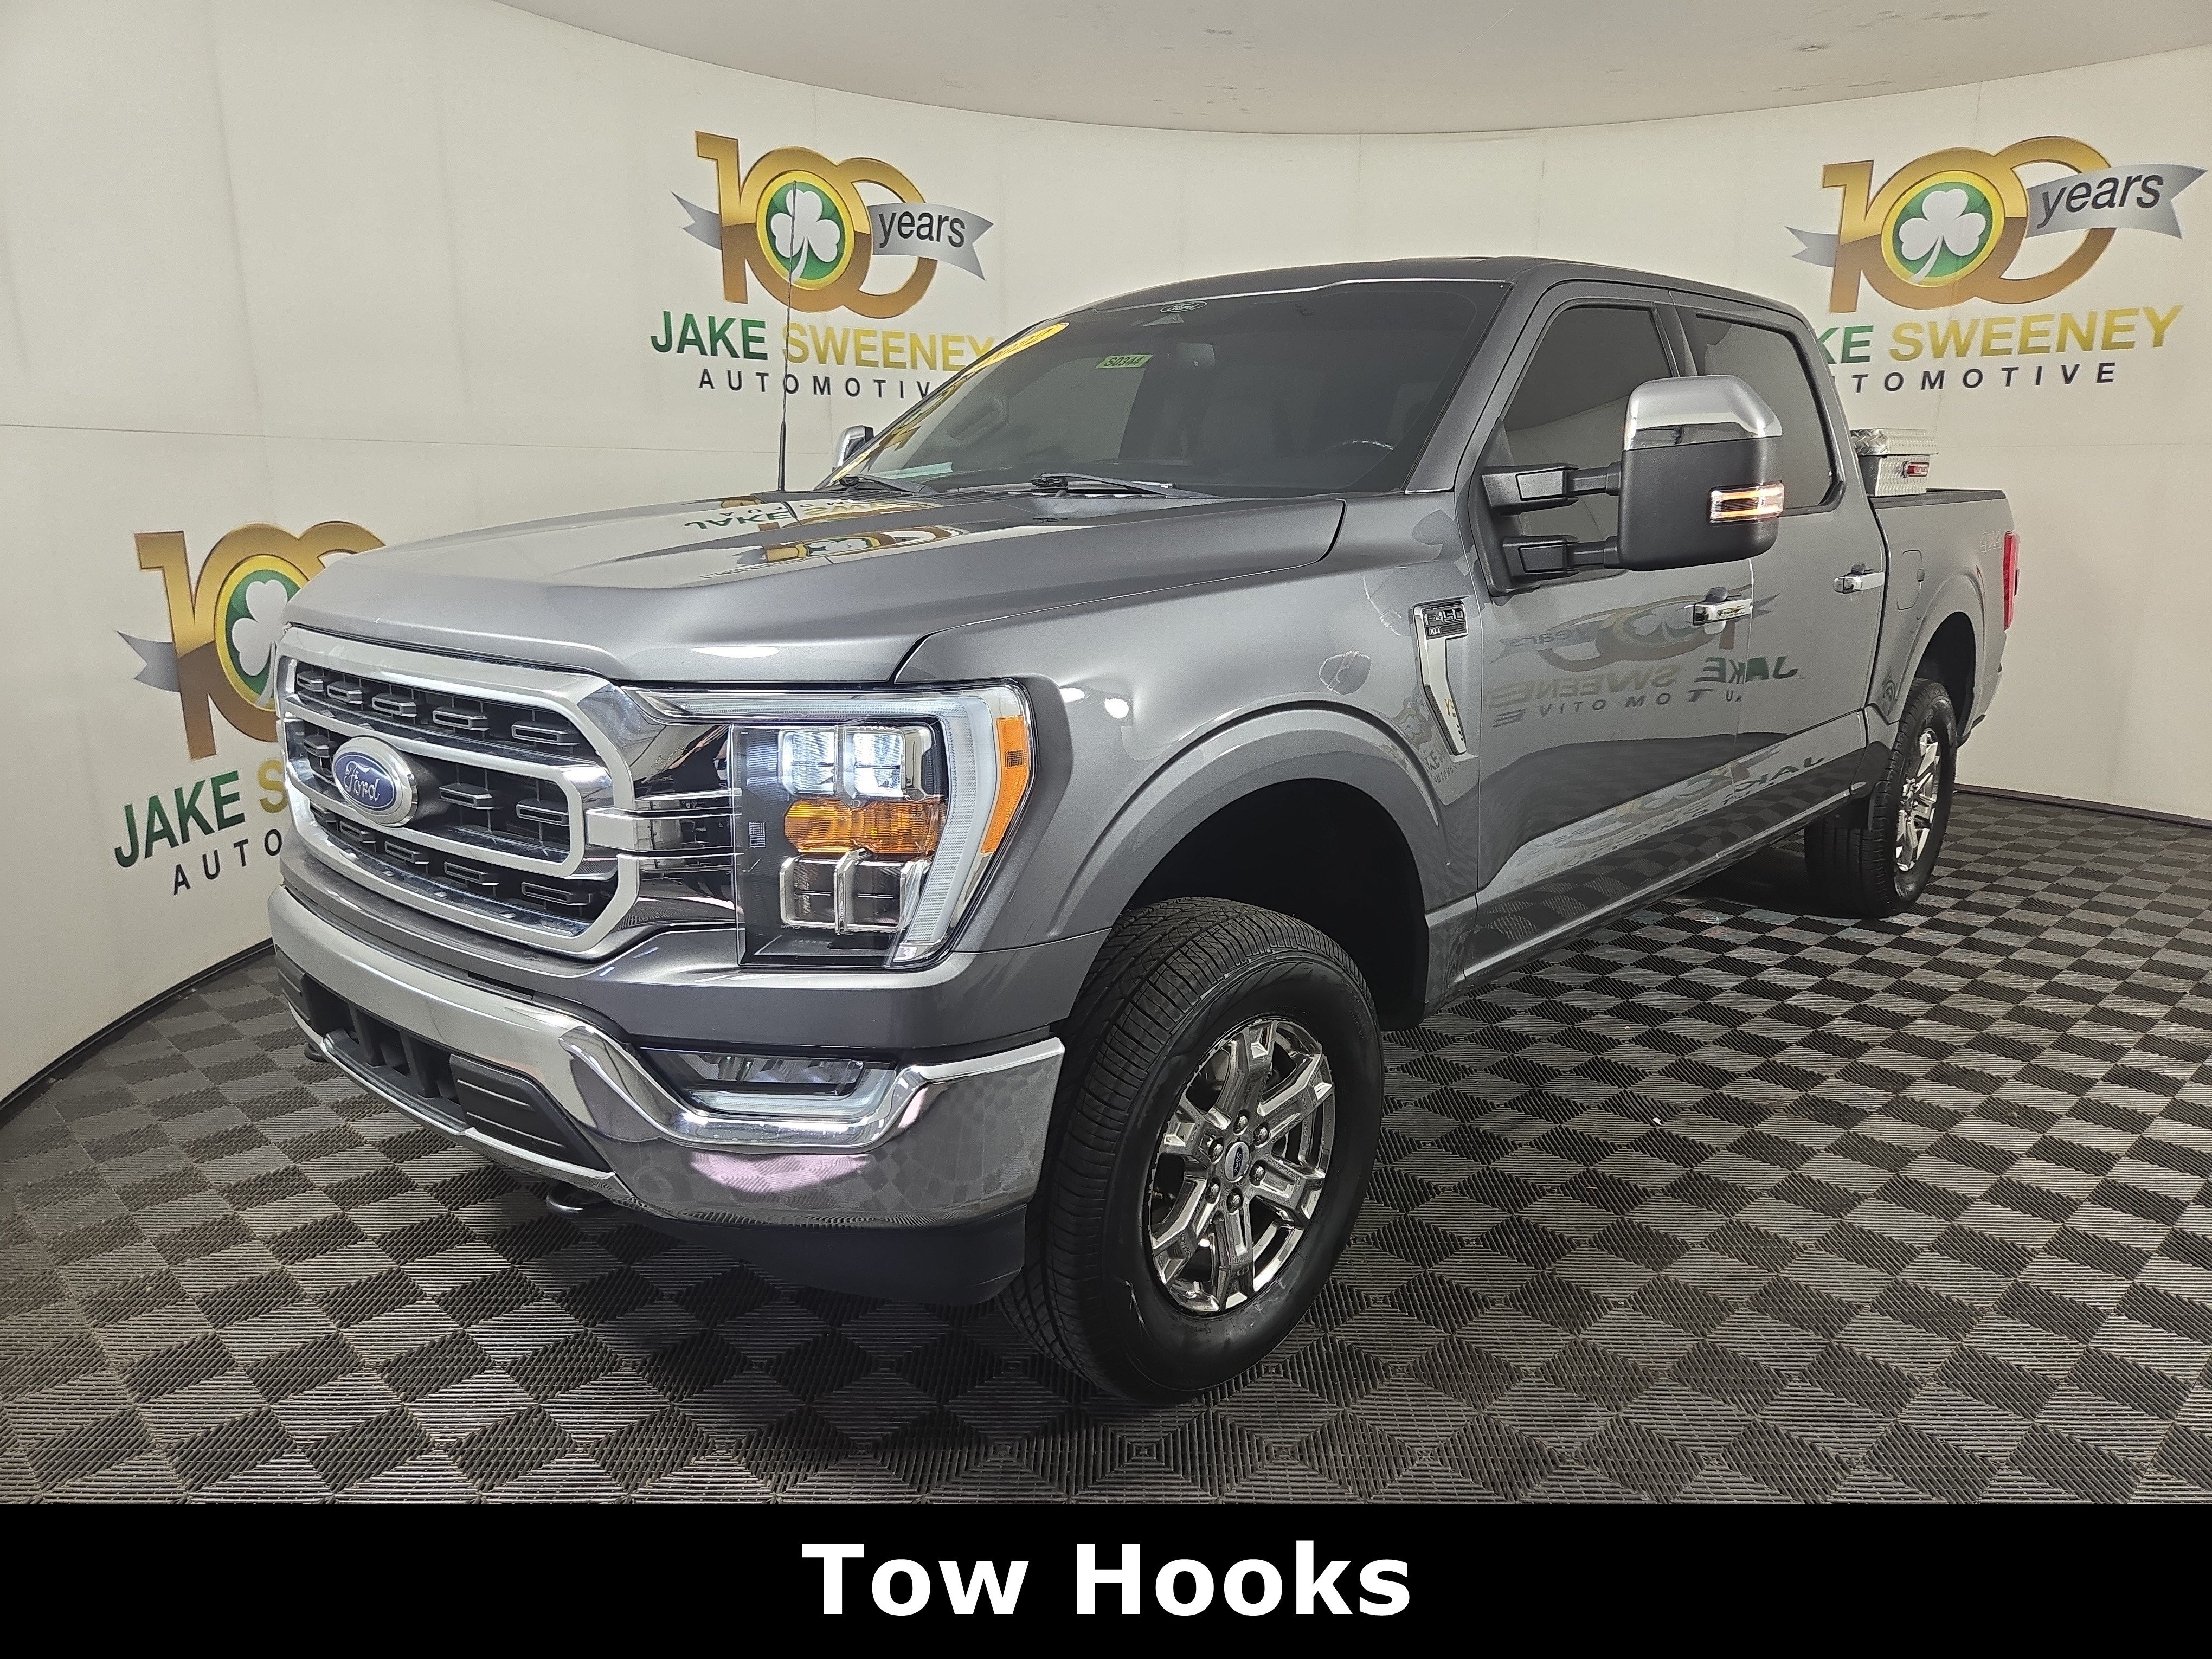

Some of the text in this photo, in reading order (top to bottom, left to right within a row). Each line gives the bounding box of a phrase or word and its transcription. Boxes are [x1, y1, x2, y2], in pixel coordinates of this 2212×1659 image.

[695, 131, 966, 319] 100 years
[1822, 136, 2164, 314] 100 years
[651, 310, 769, 361] JAKE
[1818, 304, 2185, 365] KE SWEENEY
[699, 368, 931, 400] AUTOMOTIV
[1832, 362, 2116, 394] TOMOTIVE
[1424, 609, 1464, 626] F-150
[1428, 627, 1442, 636] XLT
[344, 761, 381, 802] Ford
[114, 770, 246, 869] JAKE
